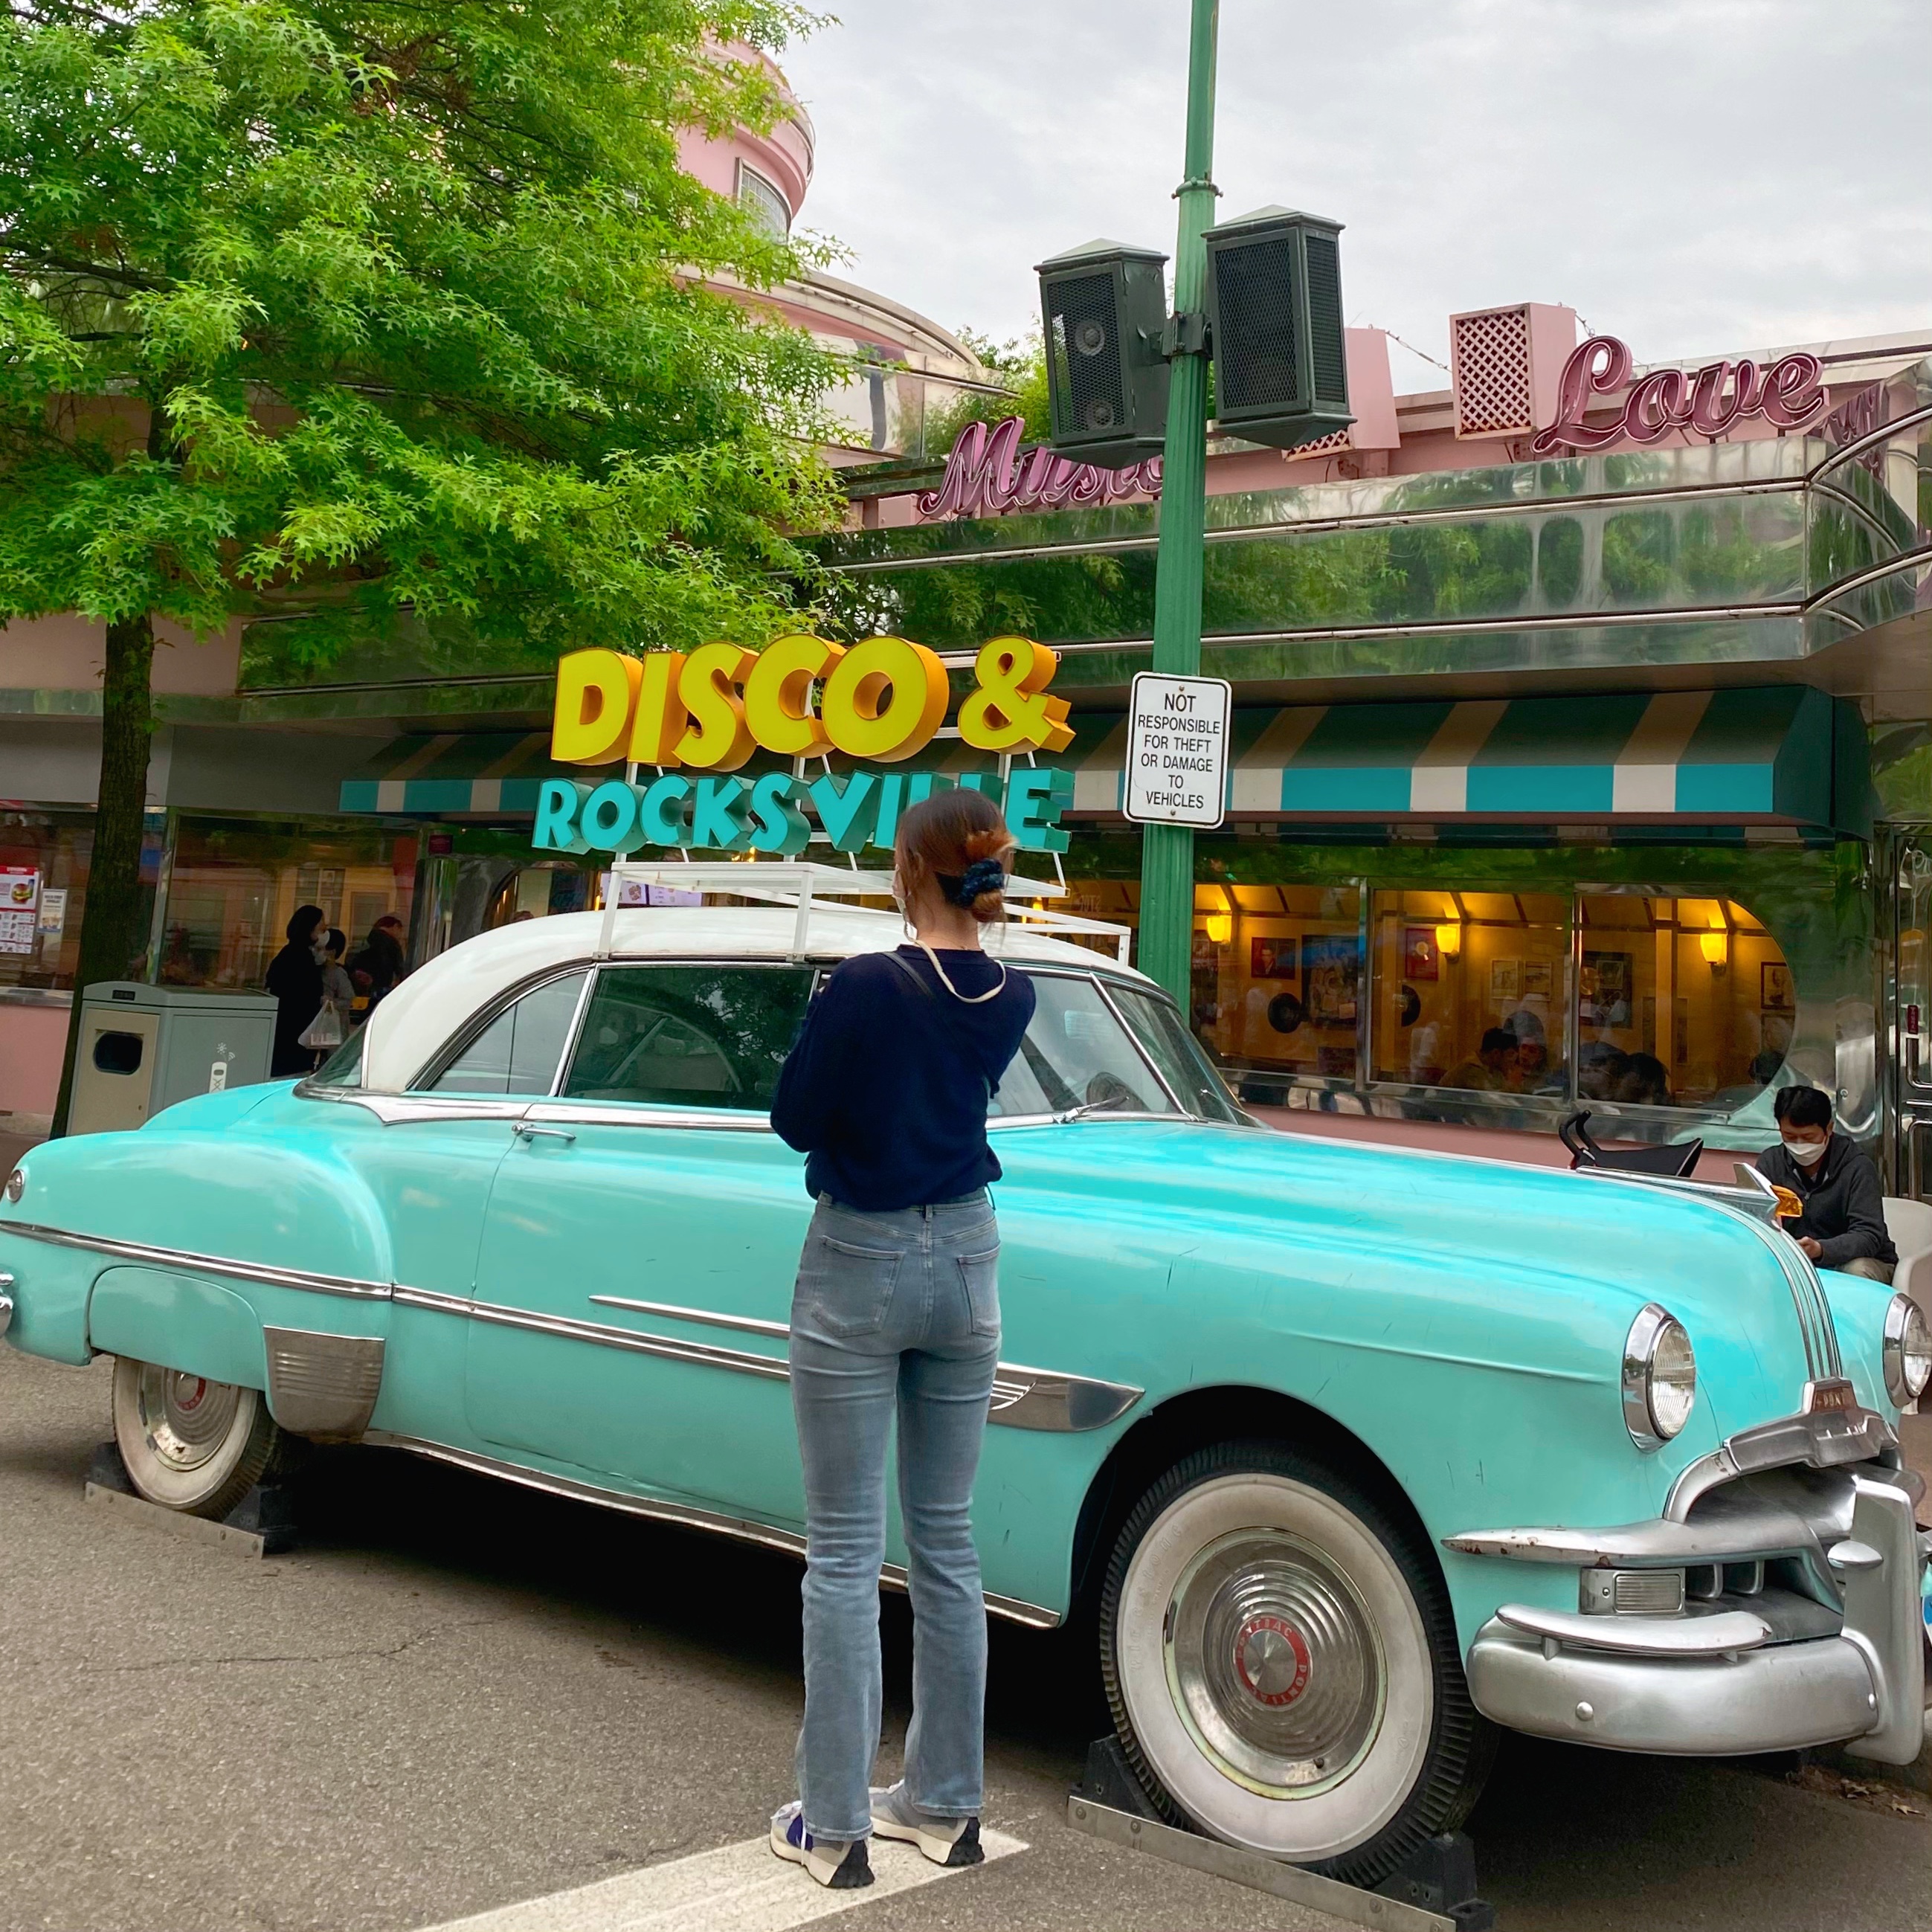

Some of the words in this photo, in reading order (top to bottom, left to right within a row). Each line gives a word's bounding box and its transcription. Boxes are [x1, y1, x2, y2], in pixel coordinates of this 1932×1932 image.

[1531, 335, 1829, 454] Love
[551, 634, 950, 770] DISCO
[958, 635, 1076, 755] &
[1164, 693, 1197, 712] NOT
[1138, 715, 1220, 734] RESPONSIBLE
[1144, 735, 1168, 750] FOR
[1173, 736, 1211, 753] THEFT
[1141, 753, 1158, 767] OR
[1163, 755, 1213, 773] DAMAGE
[1168, 774, 1184, 789] TO
[1146, 790, 1204, 809] VEHICLES
[532, 767, 1075, 854] ROCKSVIE
